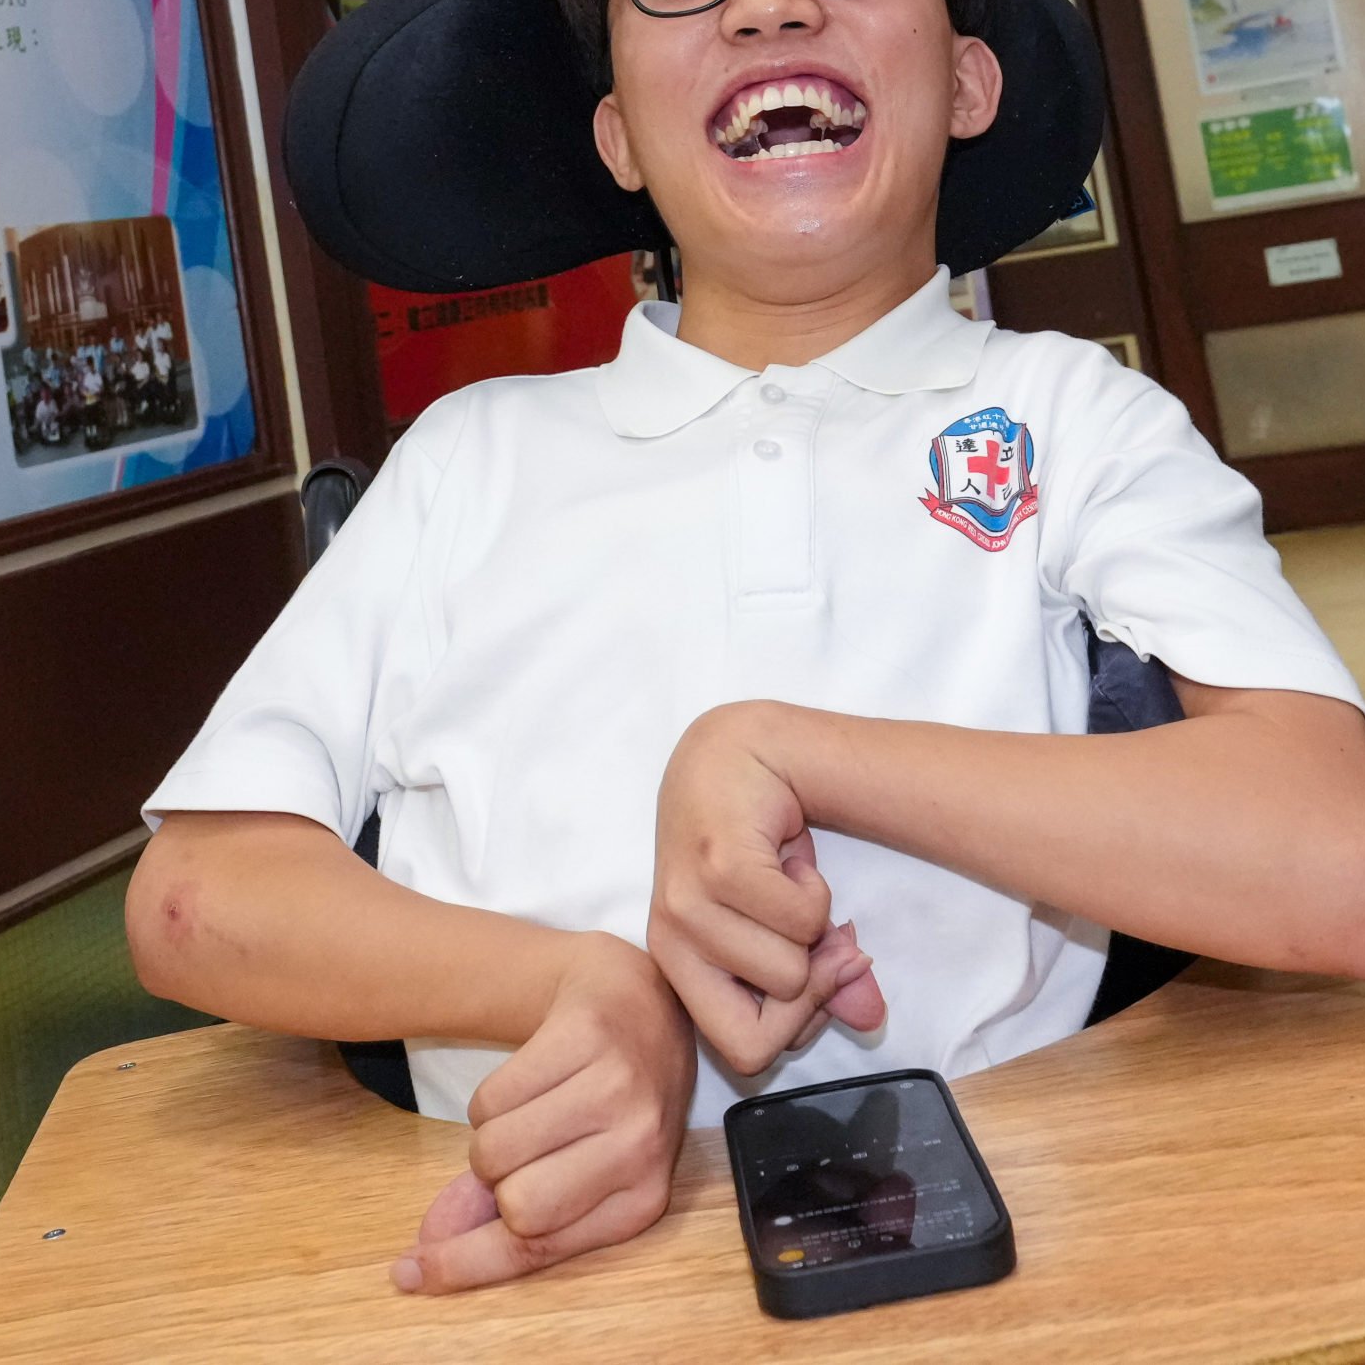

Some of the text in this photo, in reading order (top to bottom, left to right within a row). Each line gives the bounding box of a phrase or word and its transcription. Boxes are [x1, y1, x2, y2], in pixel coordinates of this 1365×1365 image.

[955, 438, 978, 453] 達
[960, 478, 981, 495] 人
[935, 507, 951, 520] HONG
[951, 515, 968, 529] KONG
